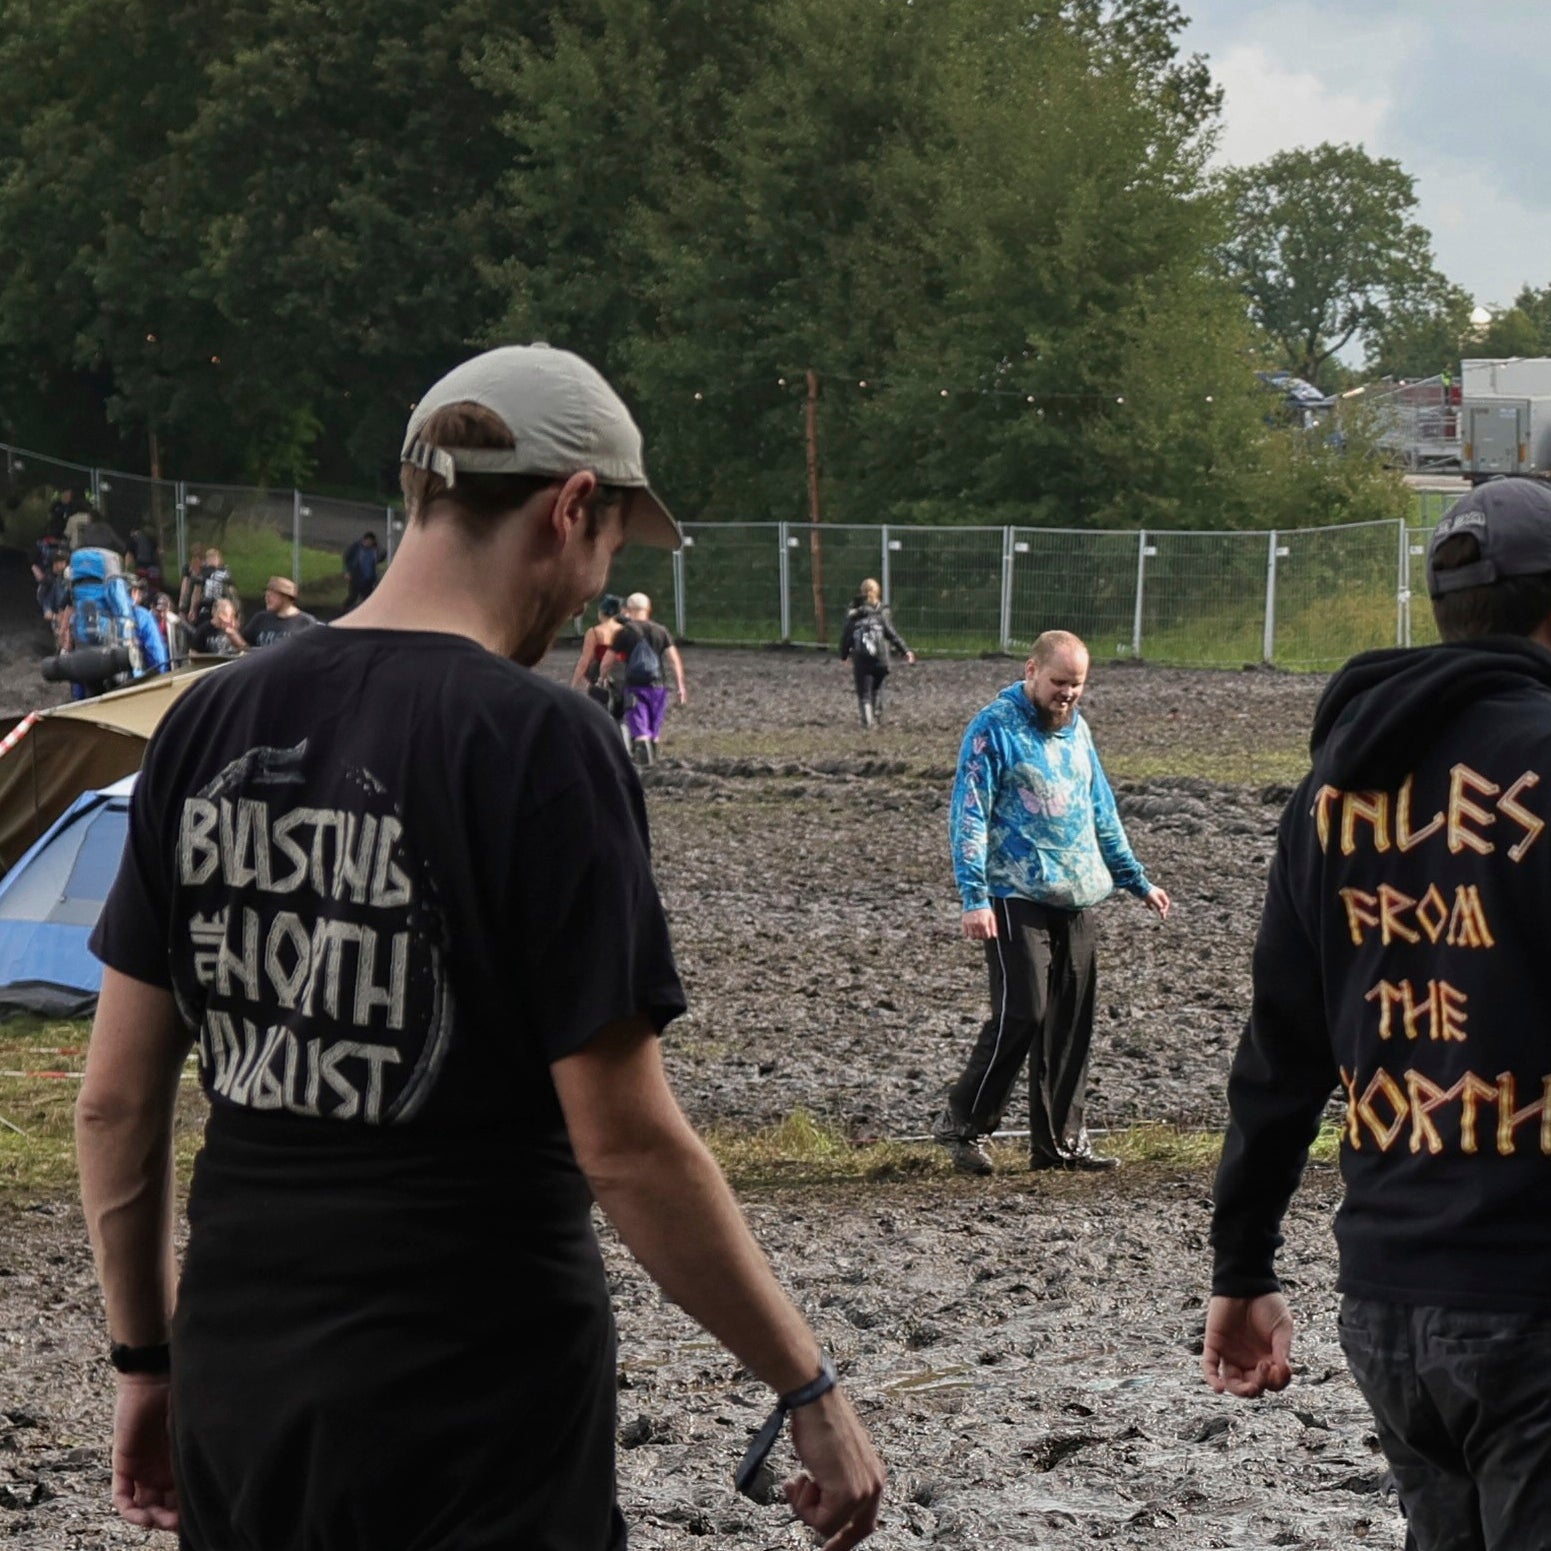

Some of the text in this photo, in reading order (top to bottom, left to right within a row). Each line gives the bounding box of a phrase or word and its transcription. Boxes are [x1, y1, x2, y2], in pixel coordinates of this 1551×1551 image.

[1310, 762, 1545, 863] TALES
[1338, 882, 1495, 948] FROM
[1364, 979, 1468, 1042] THE
